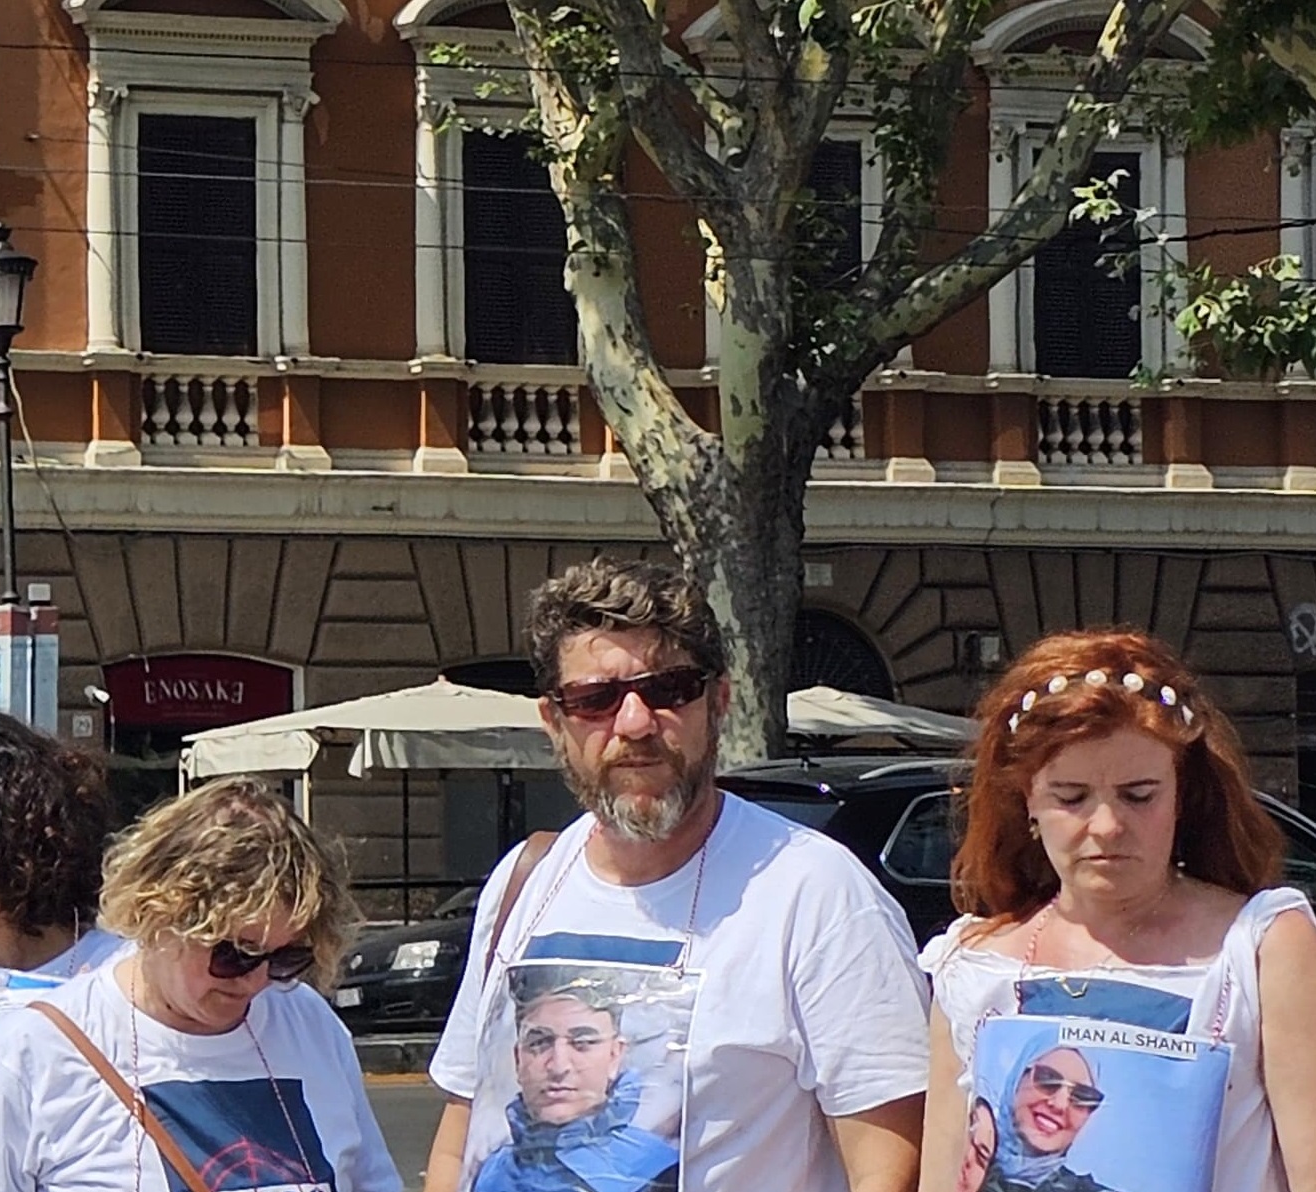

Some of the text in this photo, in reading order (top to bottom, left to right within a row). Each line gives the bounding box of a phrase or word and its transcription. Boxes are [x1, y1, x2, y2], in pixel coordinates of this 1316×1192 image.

[1061, 1027, 1196, 1054] IMAN AL SHANTI
